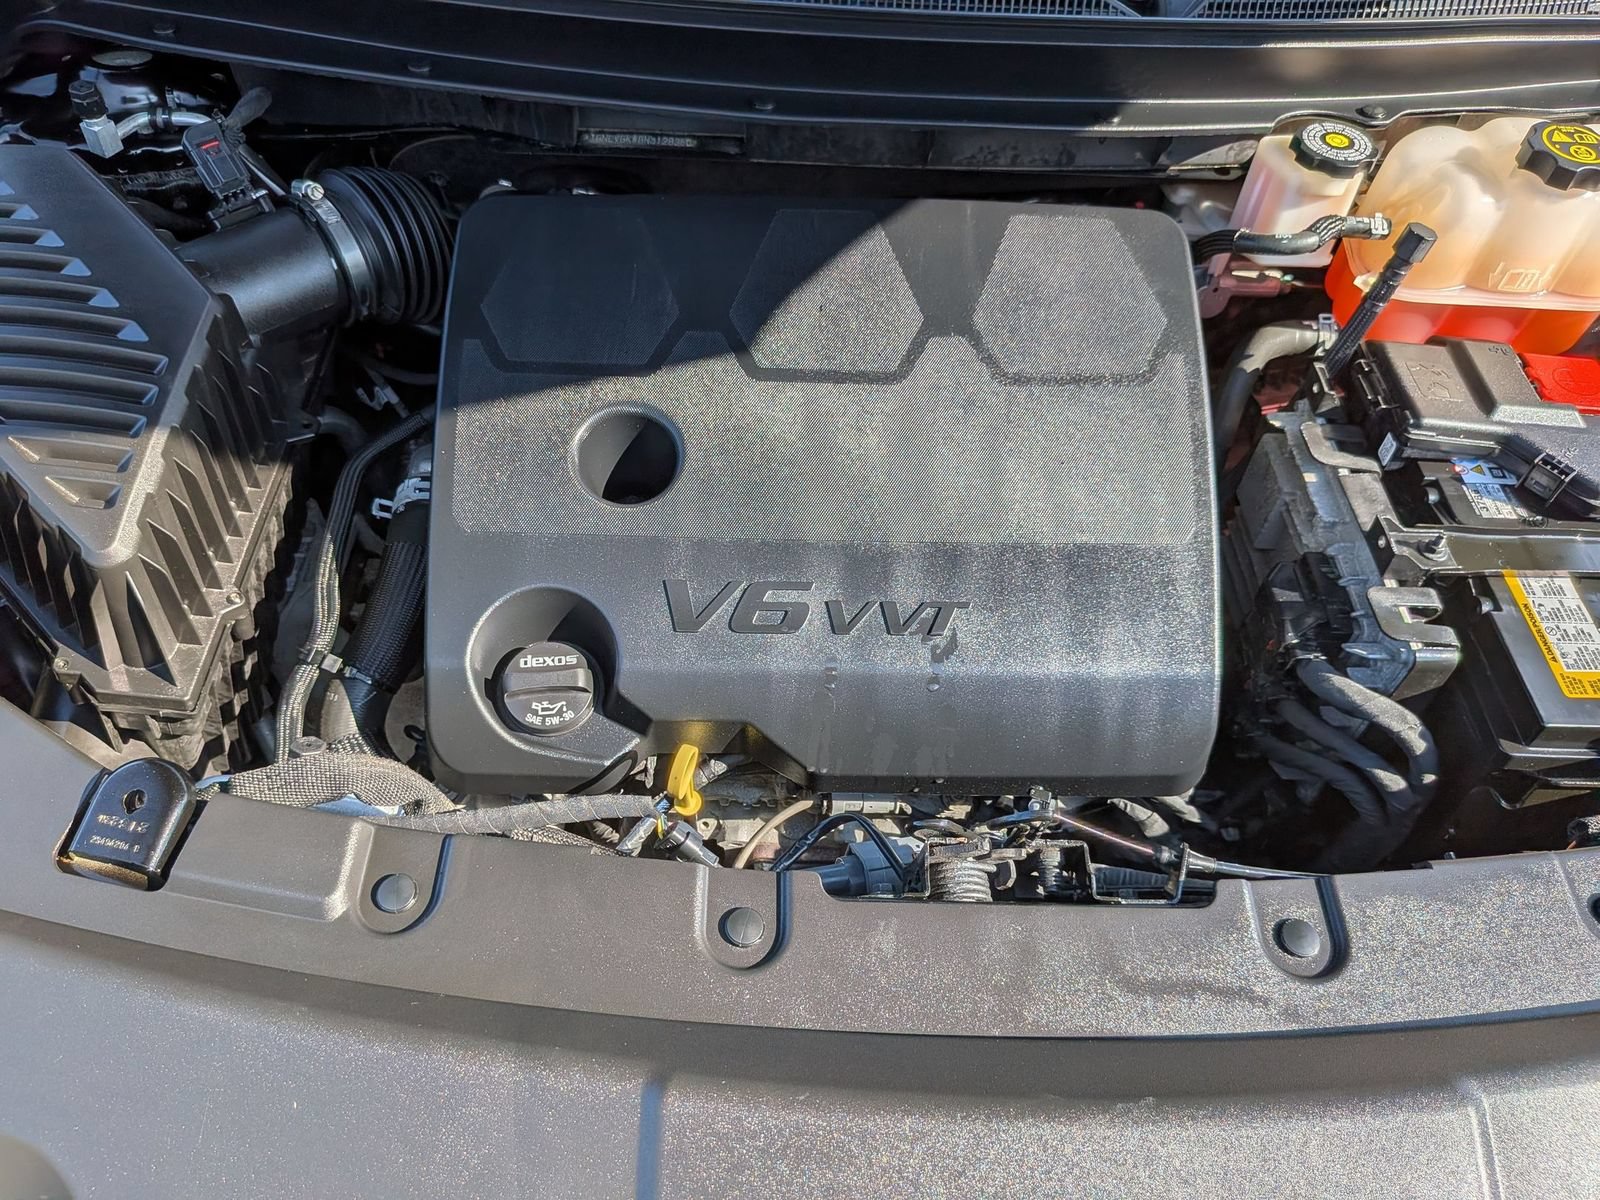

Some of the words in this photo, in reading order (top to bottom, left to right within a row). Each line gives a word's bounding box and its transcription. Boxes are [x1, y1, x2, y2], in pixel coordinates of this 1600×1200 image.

[663, 579, 815, 633] V6
[824, 600, 972, 635] VVT
[519, 655, 578, 668] dexos
[525, 714, 543, 726] SAE
[545, 710, 575, 726] 5W-30
